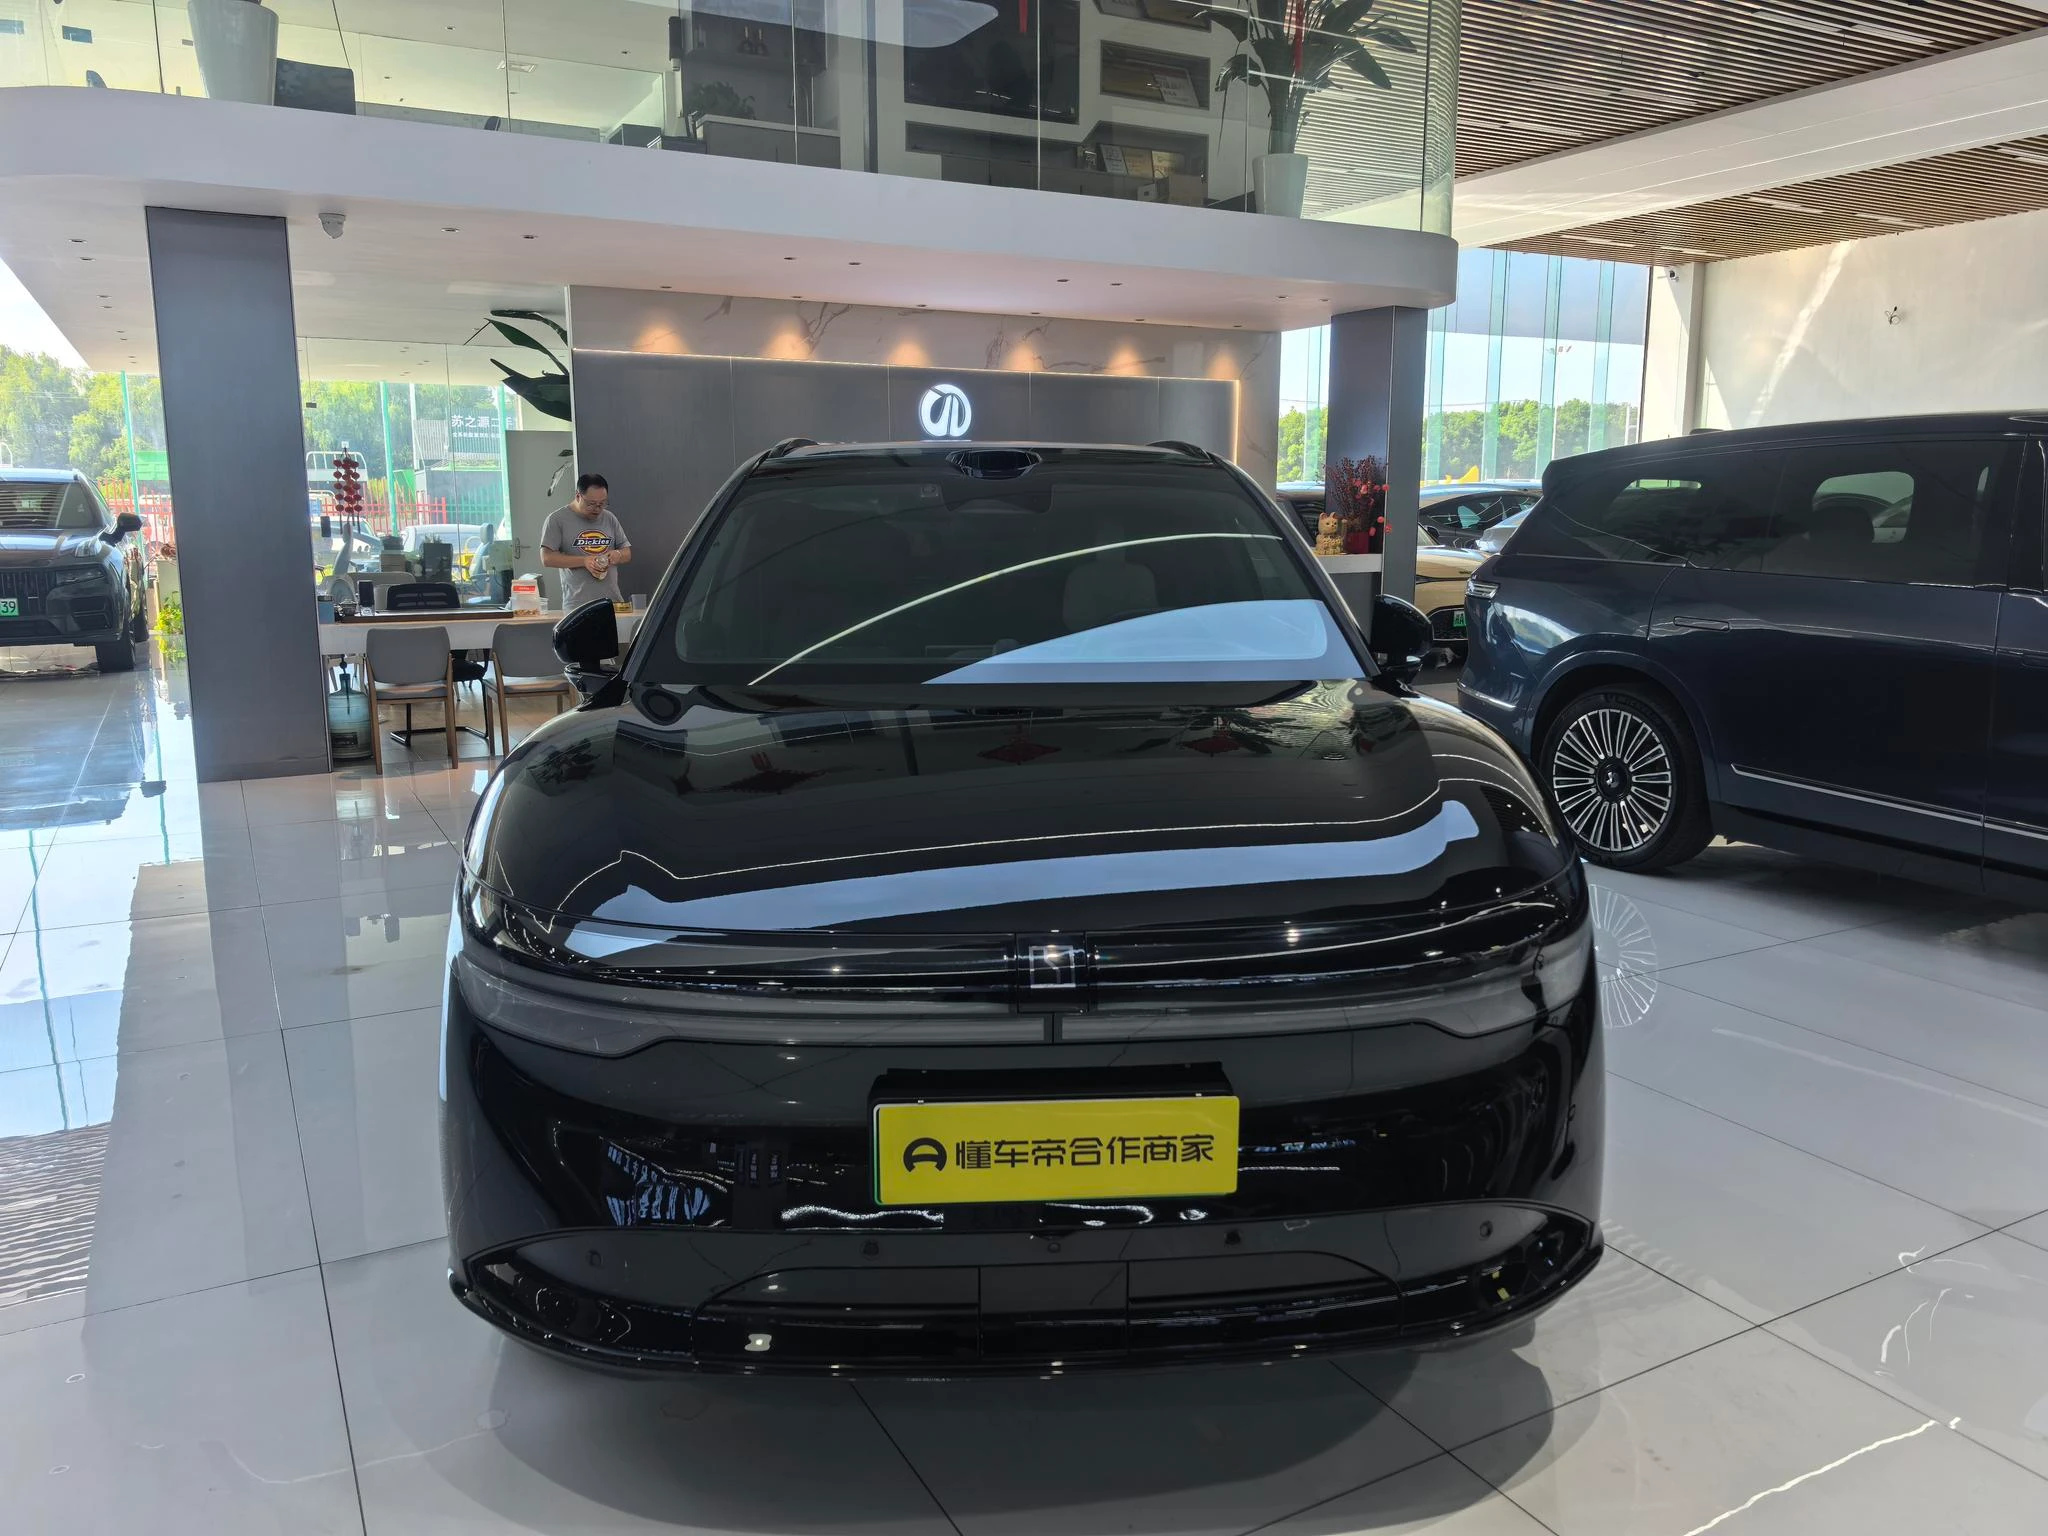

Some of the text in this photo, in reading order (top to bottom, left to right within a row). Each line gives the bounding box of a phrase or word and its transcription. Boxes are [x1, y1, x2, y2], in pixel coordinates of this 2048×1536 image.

[1, 601, 16, 614] 39
[956, 1133, 1215, 1170] 懂车帝合作商家
